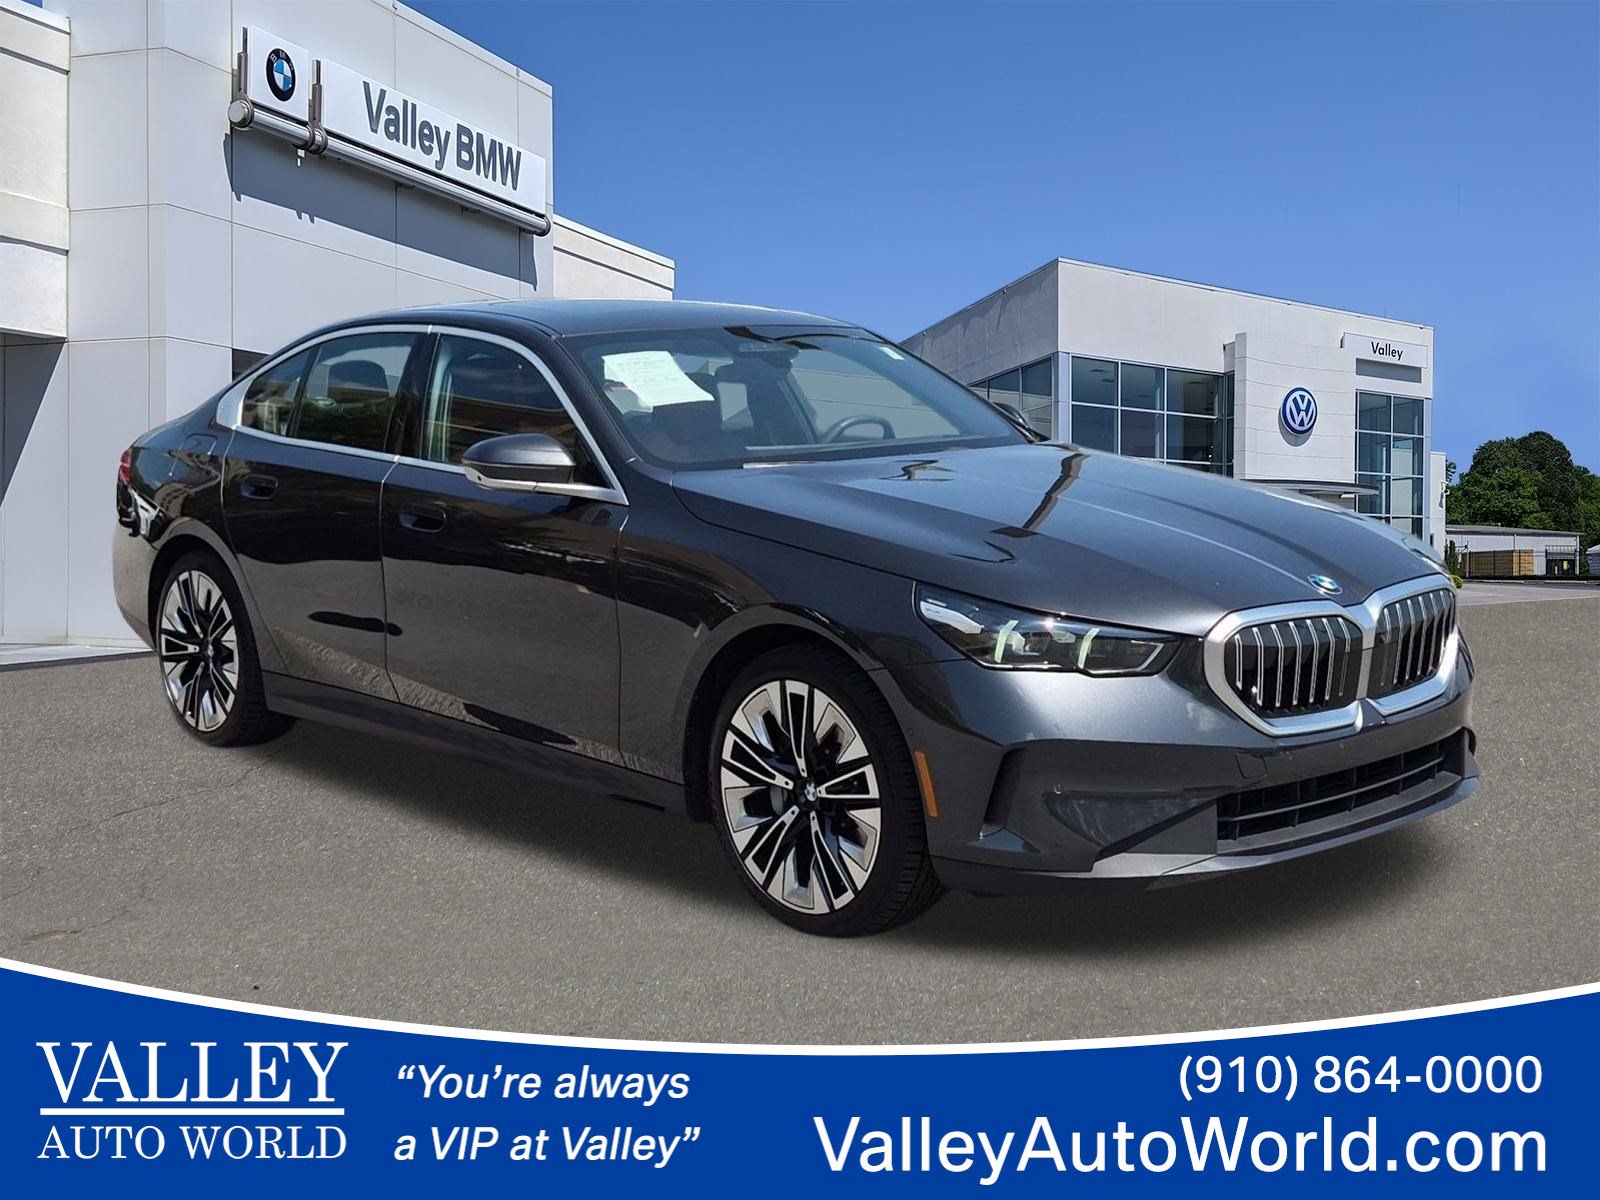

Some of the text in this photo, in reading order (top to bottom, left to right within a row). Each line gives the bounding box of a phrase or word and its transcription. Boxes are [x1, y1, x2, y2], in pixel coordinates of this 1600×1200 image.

[362, 80, 522, 192] Valley BMW
[1370, 341, 1404, 362] Valley
